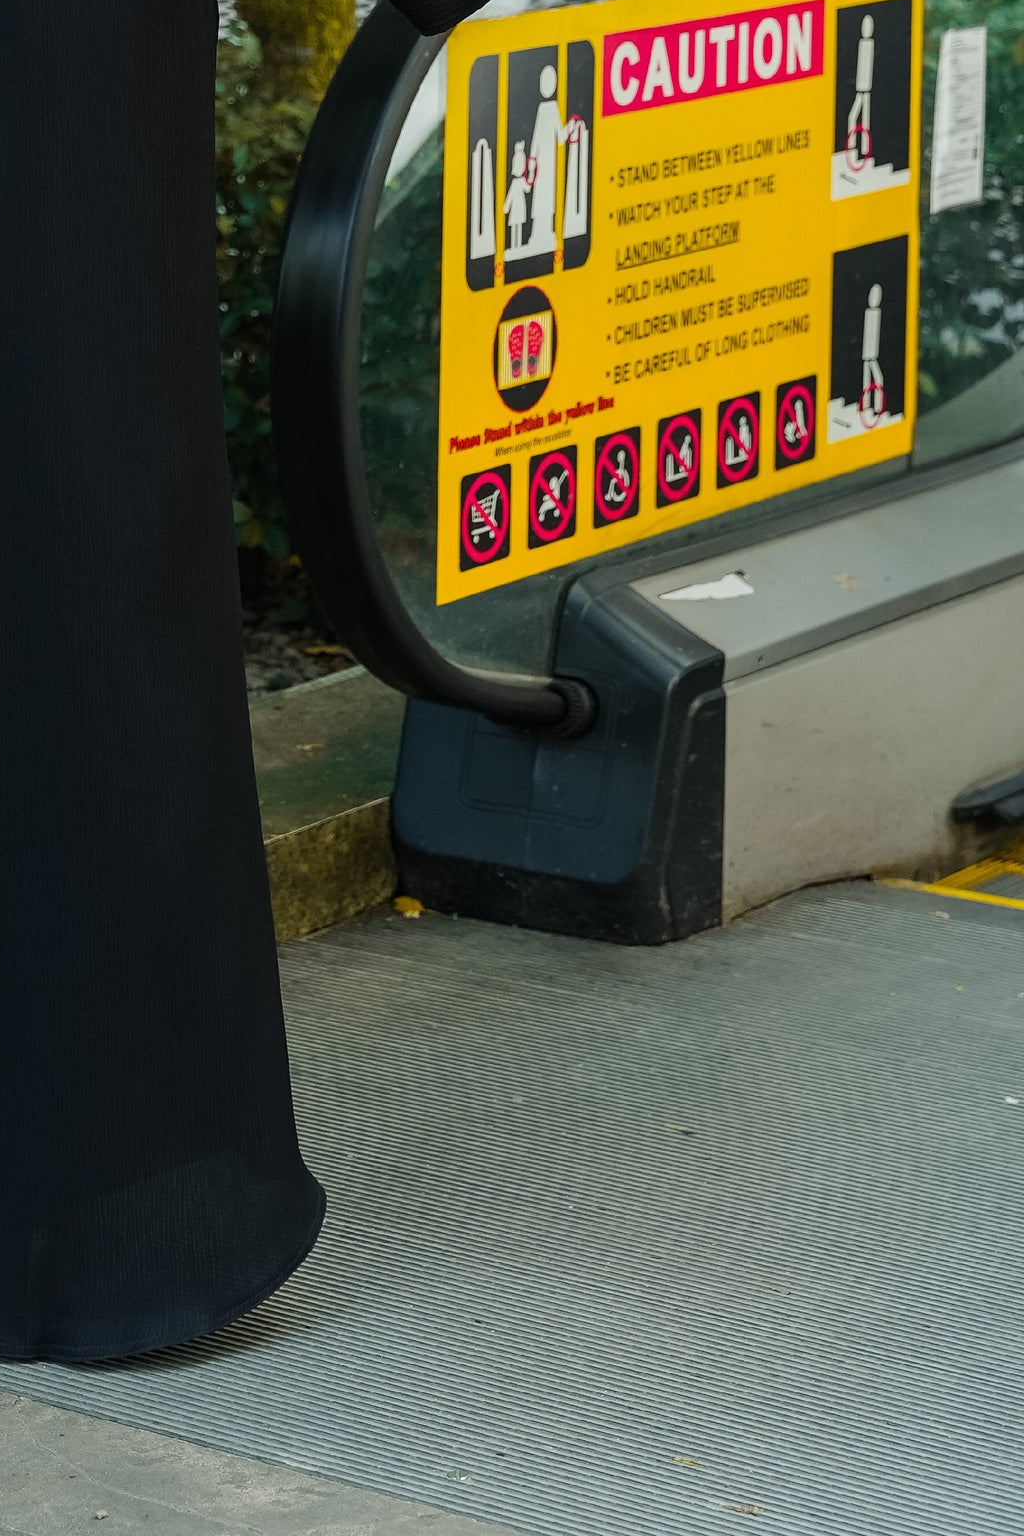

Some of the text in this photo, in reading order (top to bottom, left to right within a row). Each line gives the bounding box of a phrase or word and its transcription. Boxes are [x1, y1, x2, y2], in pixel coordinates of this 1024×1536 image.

[609, 10, 814, 107] CAUTION
[617, 129, 810, 188] STAND BETWEEN YELLOW LINES
[616, 173, 776, 228] WATCH YOUR STEP AT THE
[615, 221, 740, 268] LANDING PLATFORM
[614, 277, 810, 345] CHILDREN MUST BE SUPERVISED
[615, 264, 715, 306] HOLD HANDRAIL
[614, 314, 810, 385] BE CAREFUL OF LONG CLOTHING
